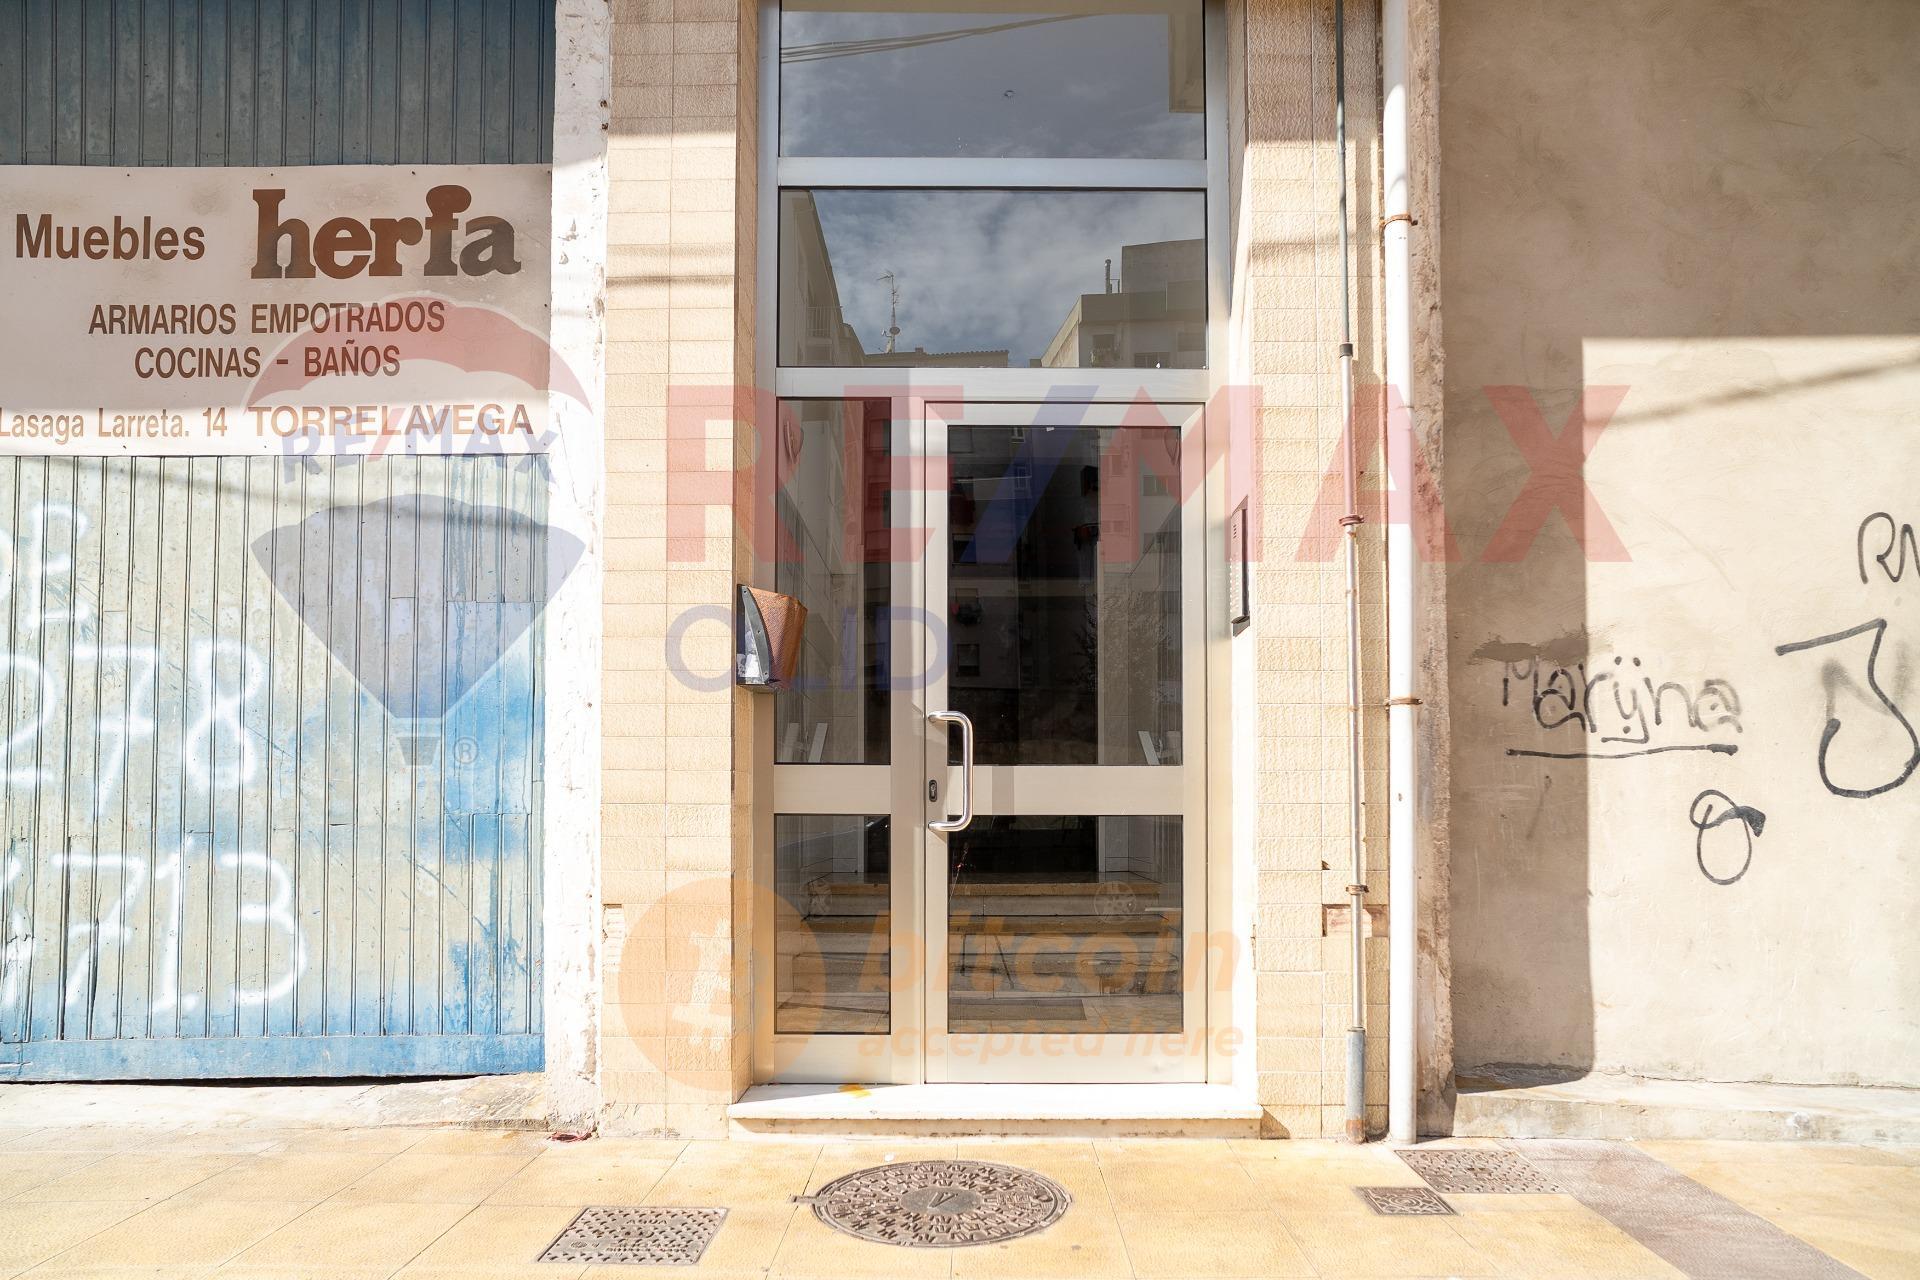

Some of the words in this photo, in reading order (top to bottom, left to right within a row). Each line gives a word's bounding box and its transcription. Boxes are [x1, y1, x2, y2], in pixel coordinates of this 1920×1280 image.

[15, 213, 206, 260] Muebles
[250, 184, 522, 280] herfa
[88, 303, 237, 335] ARMARIOS
[251, 301, 445, 334] EMPOTRADOS
[134, 346, 262, 379] COCINAS
[304, 339, 401, 377] BAÑOS
[0, 407, 84, 445] Lasaga
[202, 407, 228, 437] 14
[247, 403, 535, 437] TORRELAVEGA
